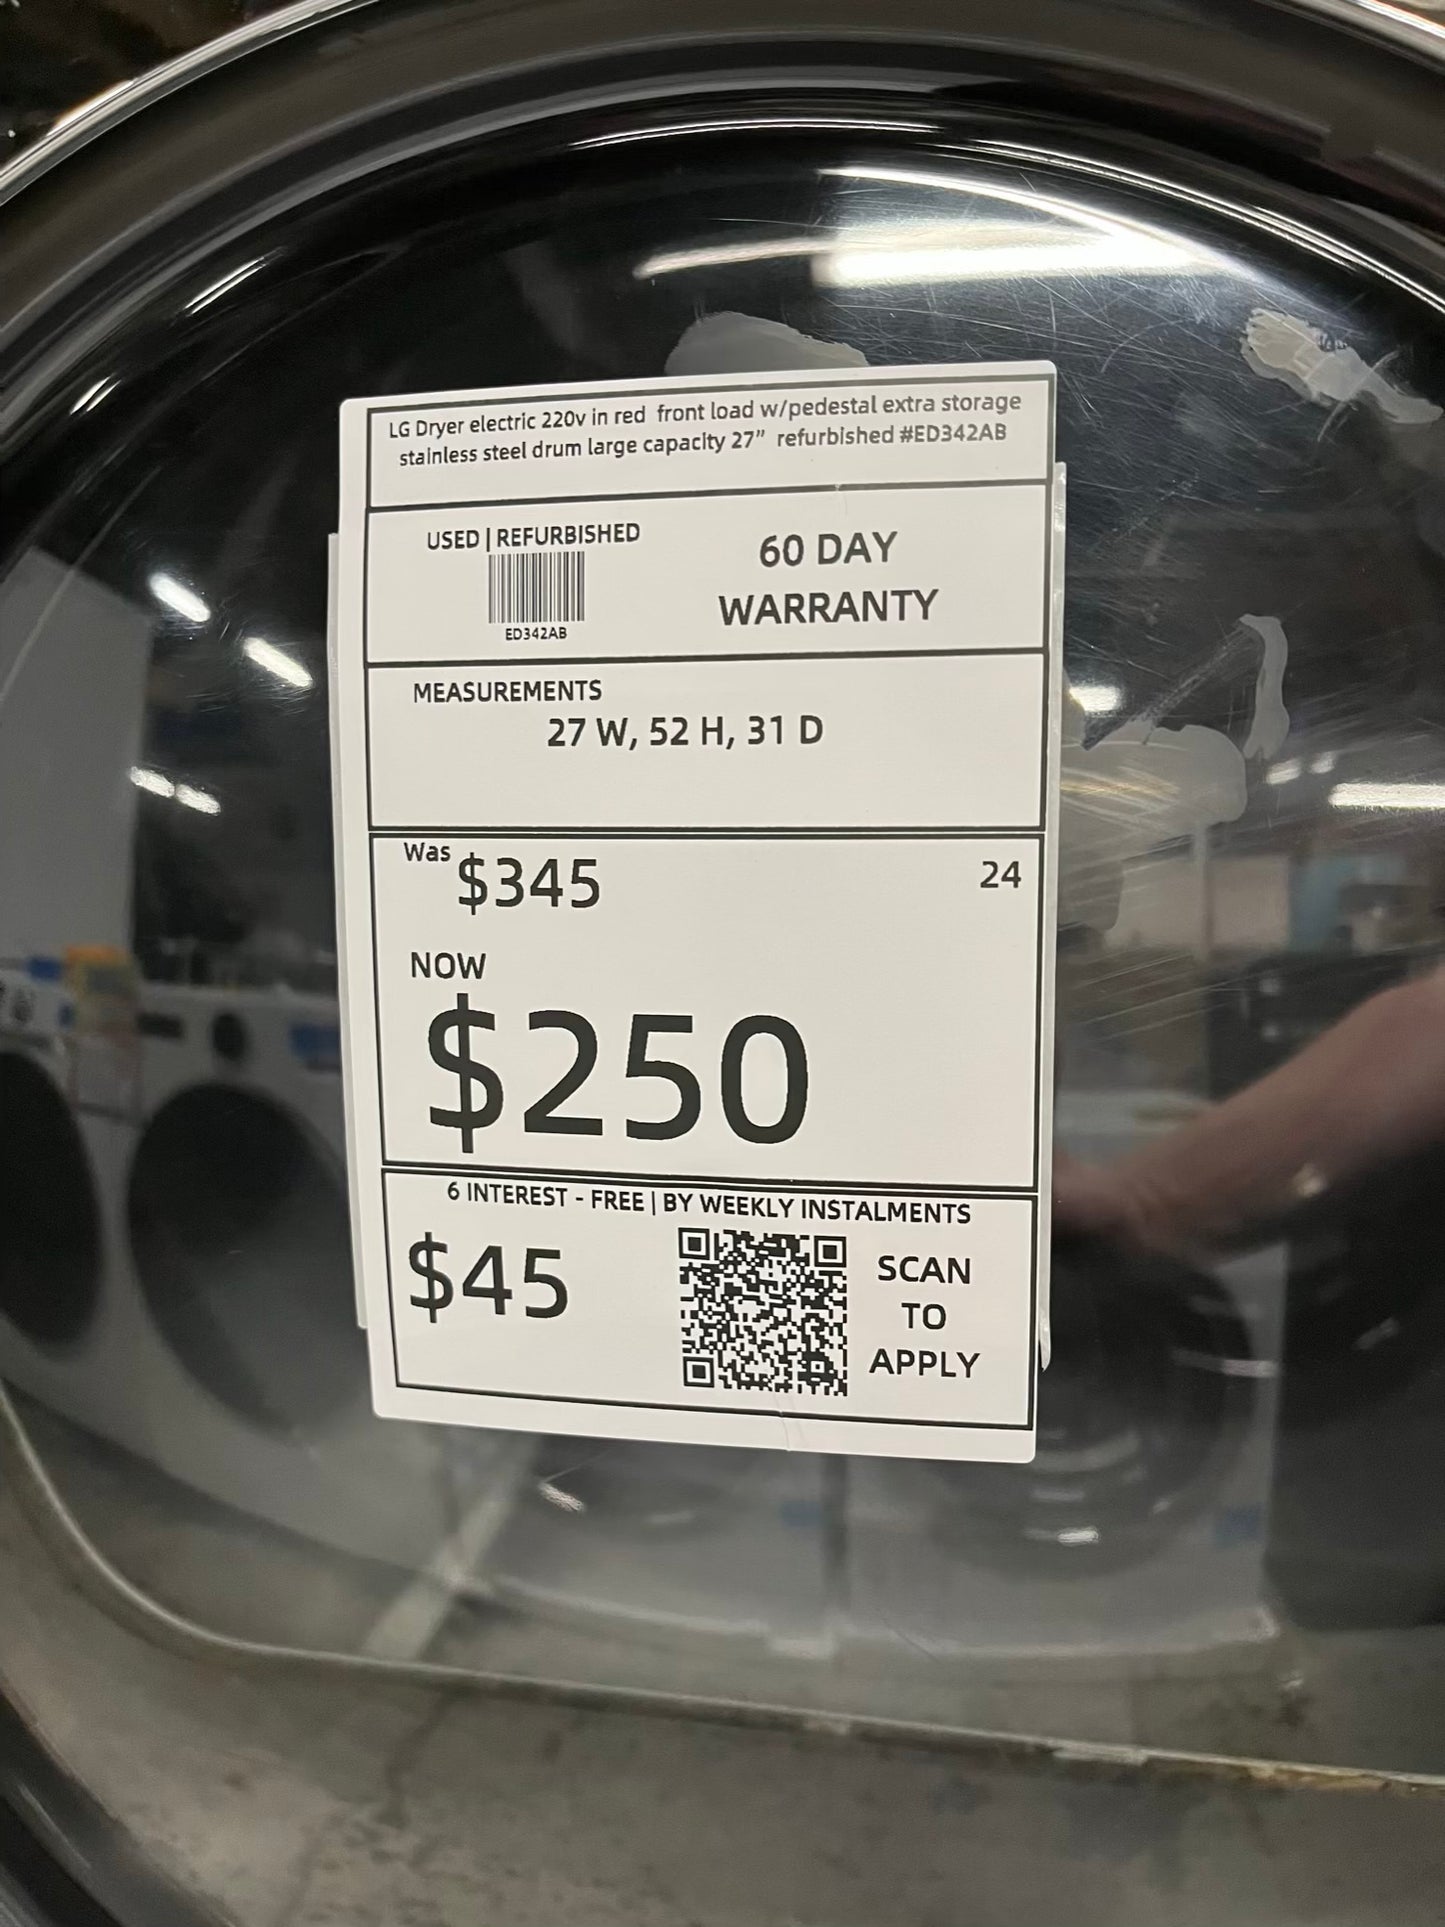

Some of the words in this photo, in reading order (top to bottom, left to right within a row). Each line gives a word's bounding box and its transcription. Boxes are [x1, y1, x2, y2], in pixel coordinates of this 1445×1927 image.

[390, 420, 409, 438] LG
[417, 418, 464, 440] Dryer
[470, 413, 535, 433] electric
[542, 409, 585, 429] 220v
[592, 407, 608, 426] in
[614, 404, 645, 424] red
[657, 404, 704, 423] front
[711, 400, 753, 420] load
[761, 395, 876, 421] w/pedestal
[883, 396, 934, 415] extra
[942, 394, 1021, 415] storage
[400, 446, 478, 466] stainless
[483, 445, 526, 462] steel
[532, 440, 581, 459] drum
[588, 437, 637, 458] large
[643, 432, 725, 454] capacity
[777, 424, 893, 447] refurbished
[899, 423, 1006, 443] #ED342AB
[427, 530, 480, 551] USED
[497, 523, 640, 548] REFURBISHED
[760, 534, 804, 568] 60
[818, 531, 898, 565] DAY
[718, 588, 939, 626] WARRANTY
[505, 627, 568, 641] ED342AB
[414, 680, 602, 703] MEASUREMENTS
[548, 718, 586, 747] 27
[596, 717, 638, 751] W,
[650, 716, 689, 746] 52
[701, 715, 738, 750] H,
[747, 715, 782, 745] 31
[800, 714, 823, 745] D
[404, 841, 451, 862] Was
[458, 851, 600, 915] $345
[980, 860, 1022, 889] 24
[411, 951, 487, 980] NOW
[427, 992, 809, 1154] $250
[447, 1181, 460, 1201] 6
[467, 1182, 568, 1207] INTEREST
[591, 1189, 645, 1212] FREE
[663, 1192, 694, 1213] BY
[699, 1193, 795, 1219] WEEKLY
[801, 1198, 972, 1225] INSTALMENTS
[408, 1231, 568, 1324] $45
[877, 1255, 971, 1285] SCAN
[901, 1302, 947, 1330] TO
[868, 1348, 981, 1379] APPLY
